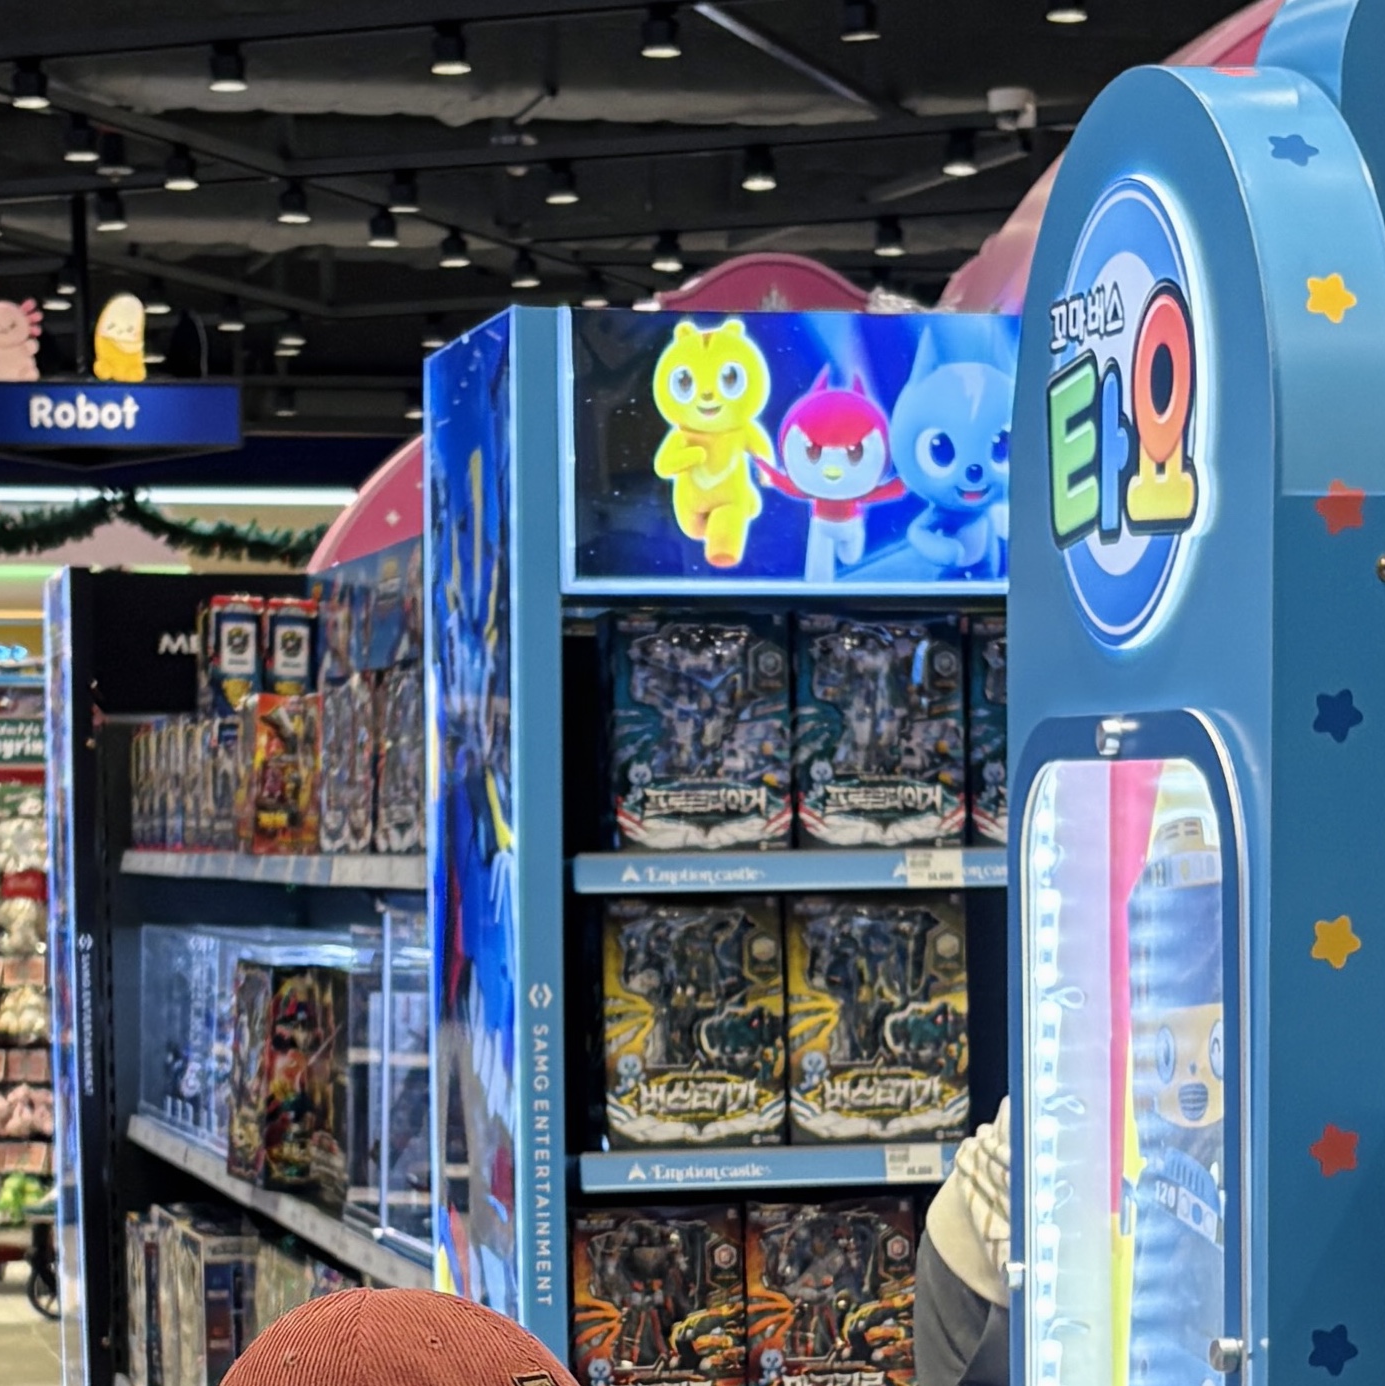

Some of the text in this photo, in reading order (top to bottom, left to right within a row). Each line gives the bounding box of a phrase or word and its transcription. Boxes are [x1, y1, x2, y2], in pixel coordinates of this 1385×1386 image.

[1050, 280, 1124, 352] 꼬마버스
[28, 393, 140, 432] Robot
[1047, 280, 1199, 549] 타요
[531, 1023, 554, 1307] SAMG ENTERTAINMENT
